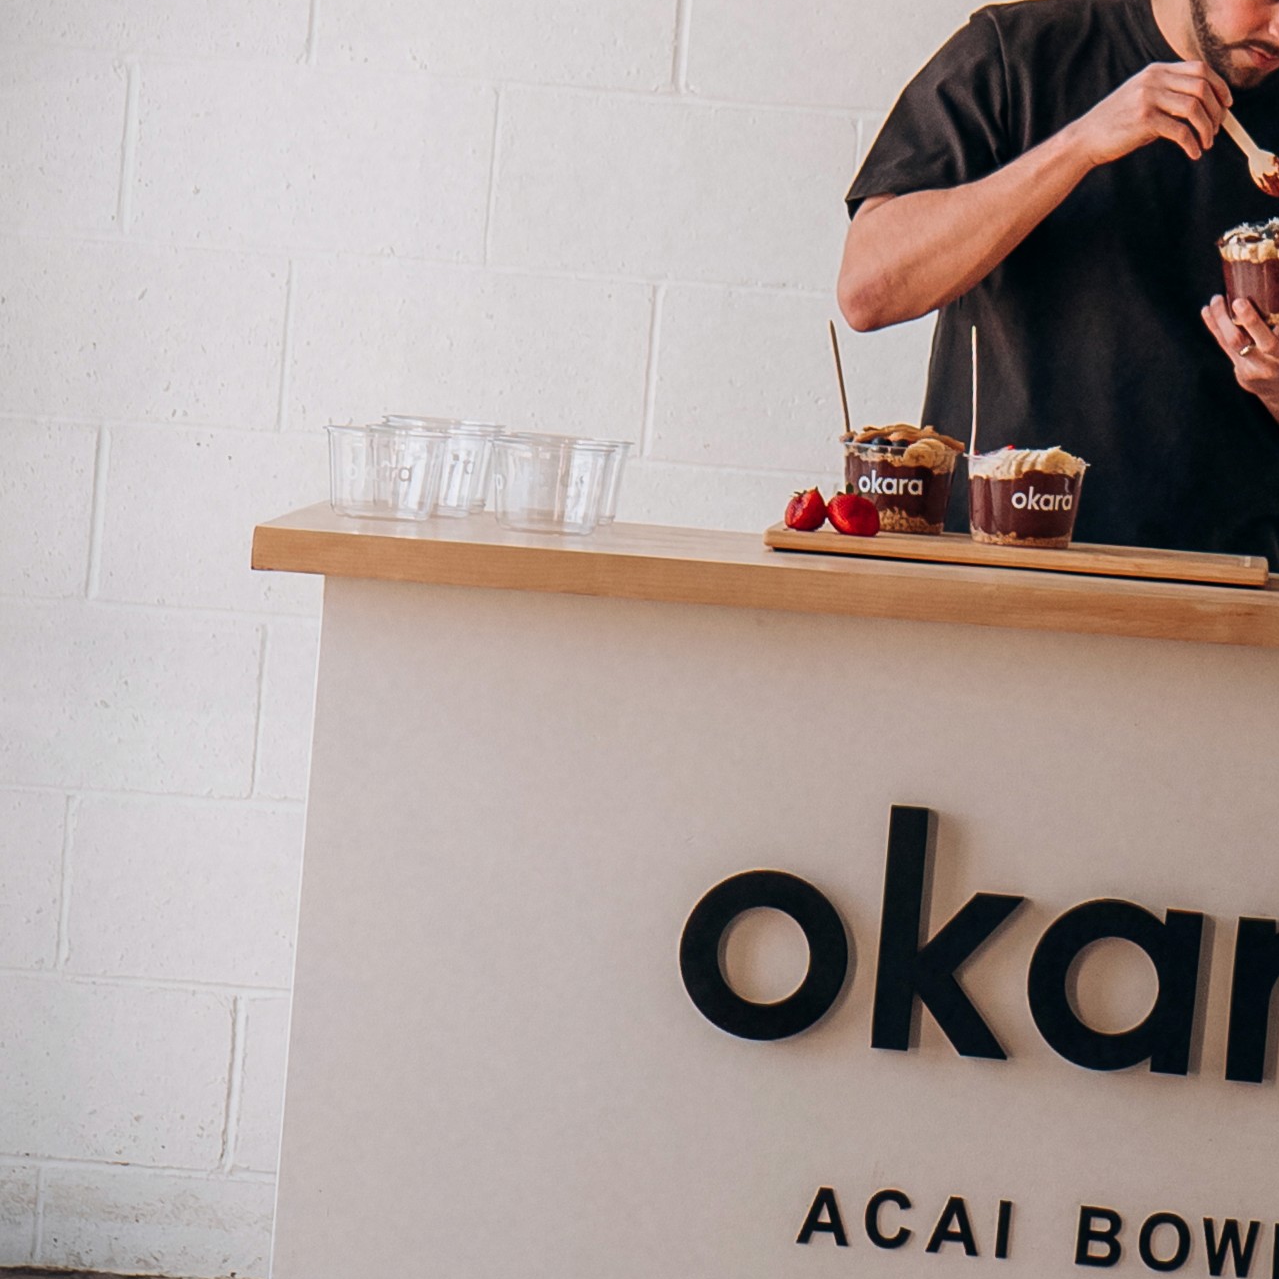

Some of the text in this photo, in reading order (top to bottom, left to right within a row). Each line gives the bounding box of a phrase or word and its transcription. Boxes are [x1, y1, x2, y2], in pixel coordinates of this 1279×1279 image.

[858, 471, 923, 496] okara
[1011, 486, 1073, 511] okara
[796, 1187, 1013, 1259] ACAI
